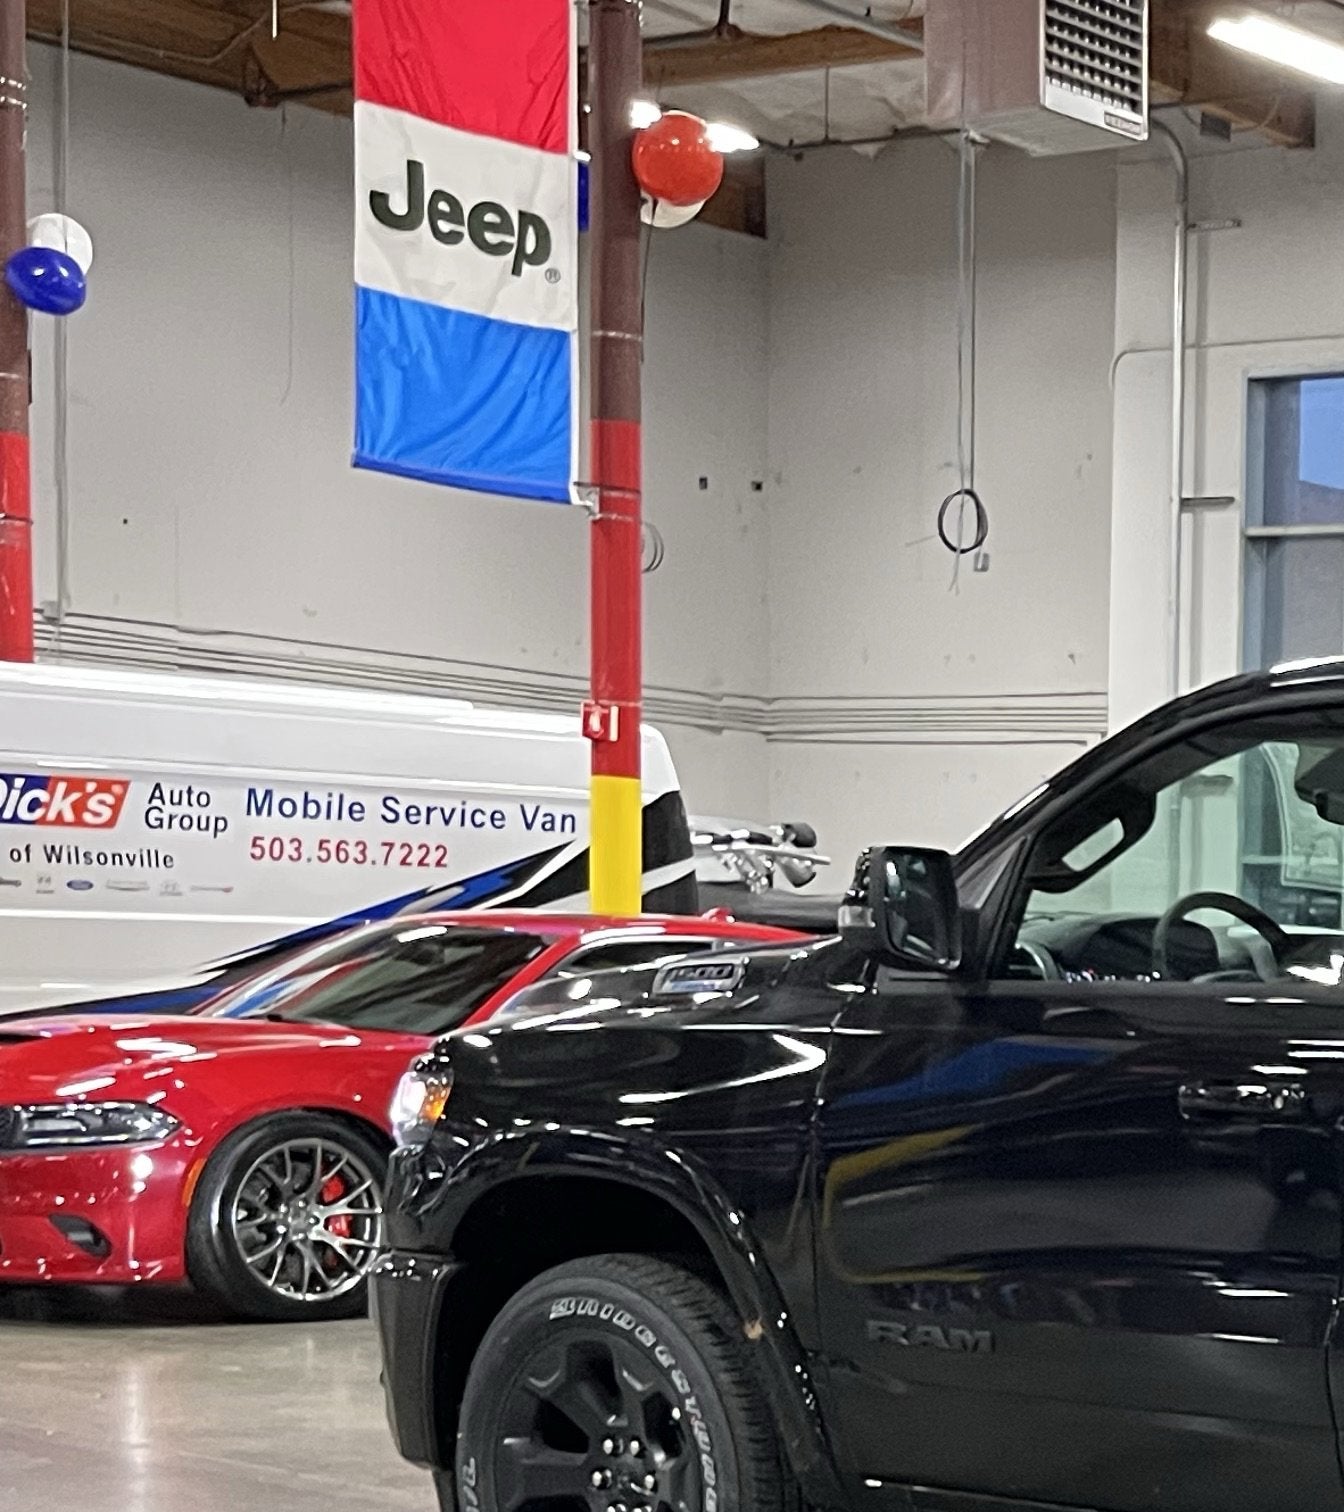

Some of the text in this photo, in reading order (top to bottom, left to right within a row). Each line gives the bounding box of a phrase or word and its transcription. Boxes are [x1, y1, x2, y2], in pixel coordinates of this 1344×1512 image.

[369, 159, 552, 277] Jeep
[148, 782, 212, 808] Auto
[246, 787, 577, 834] Mobile Service Van
[144, 806, 229, 839] Group
[10, 843, 175, 869] of Wilsonville
[250, 836, 449, 869] 503.563.7222
[866, 1319, 996, 1352] RAM
